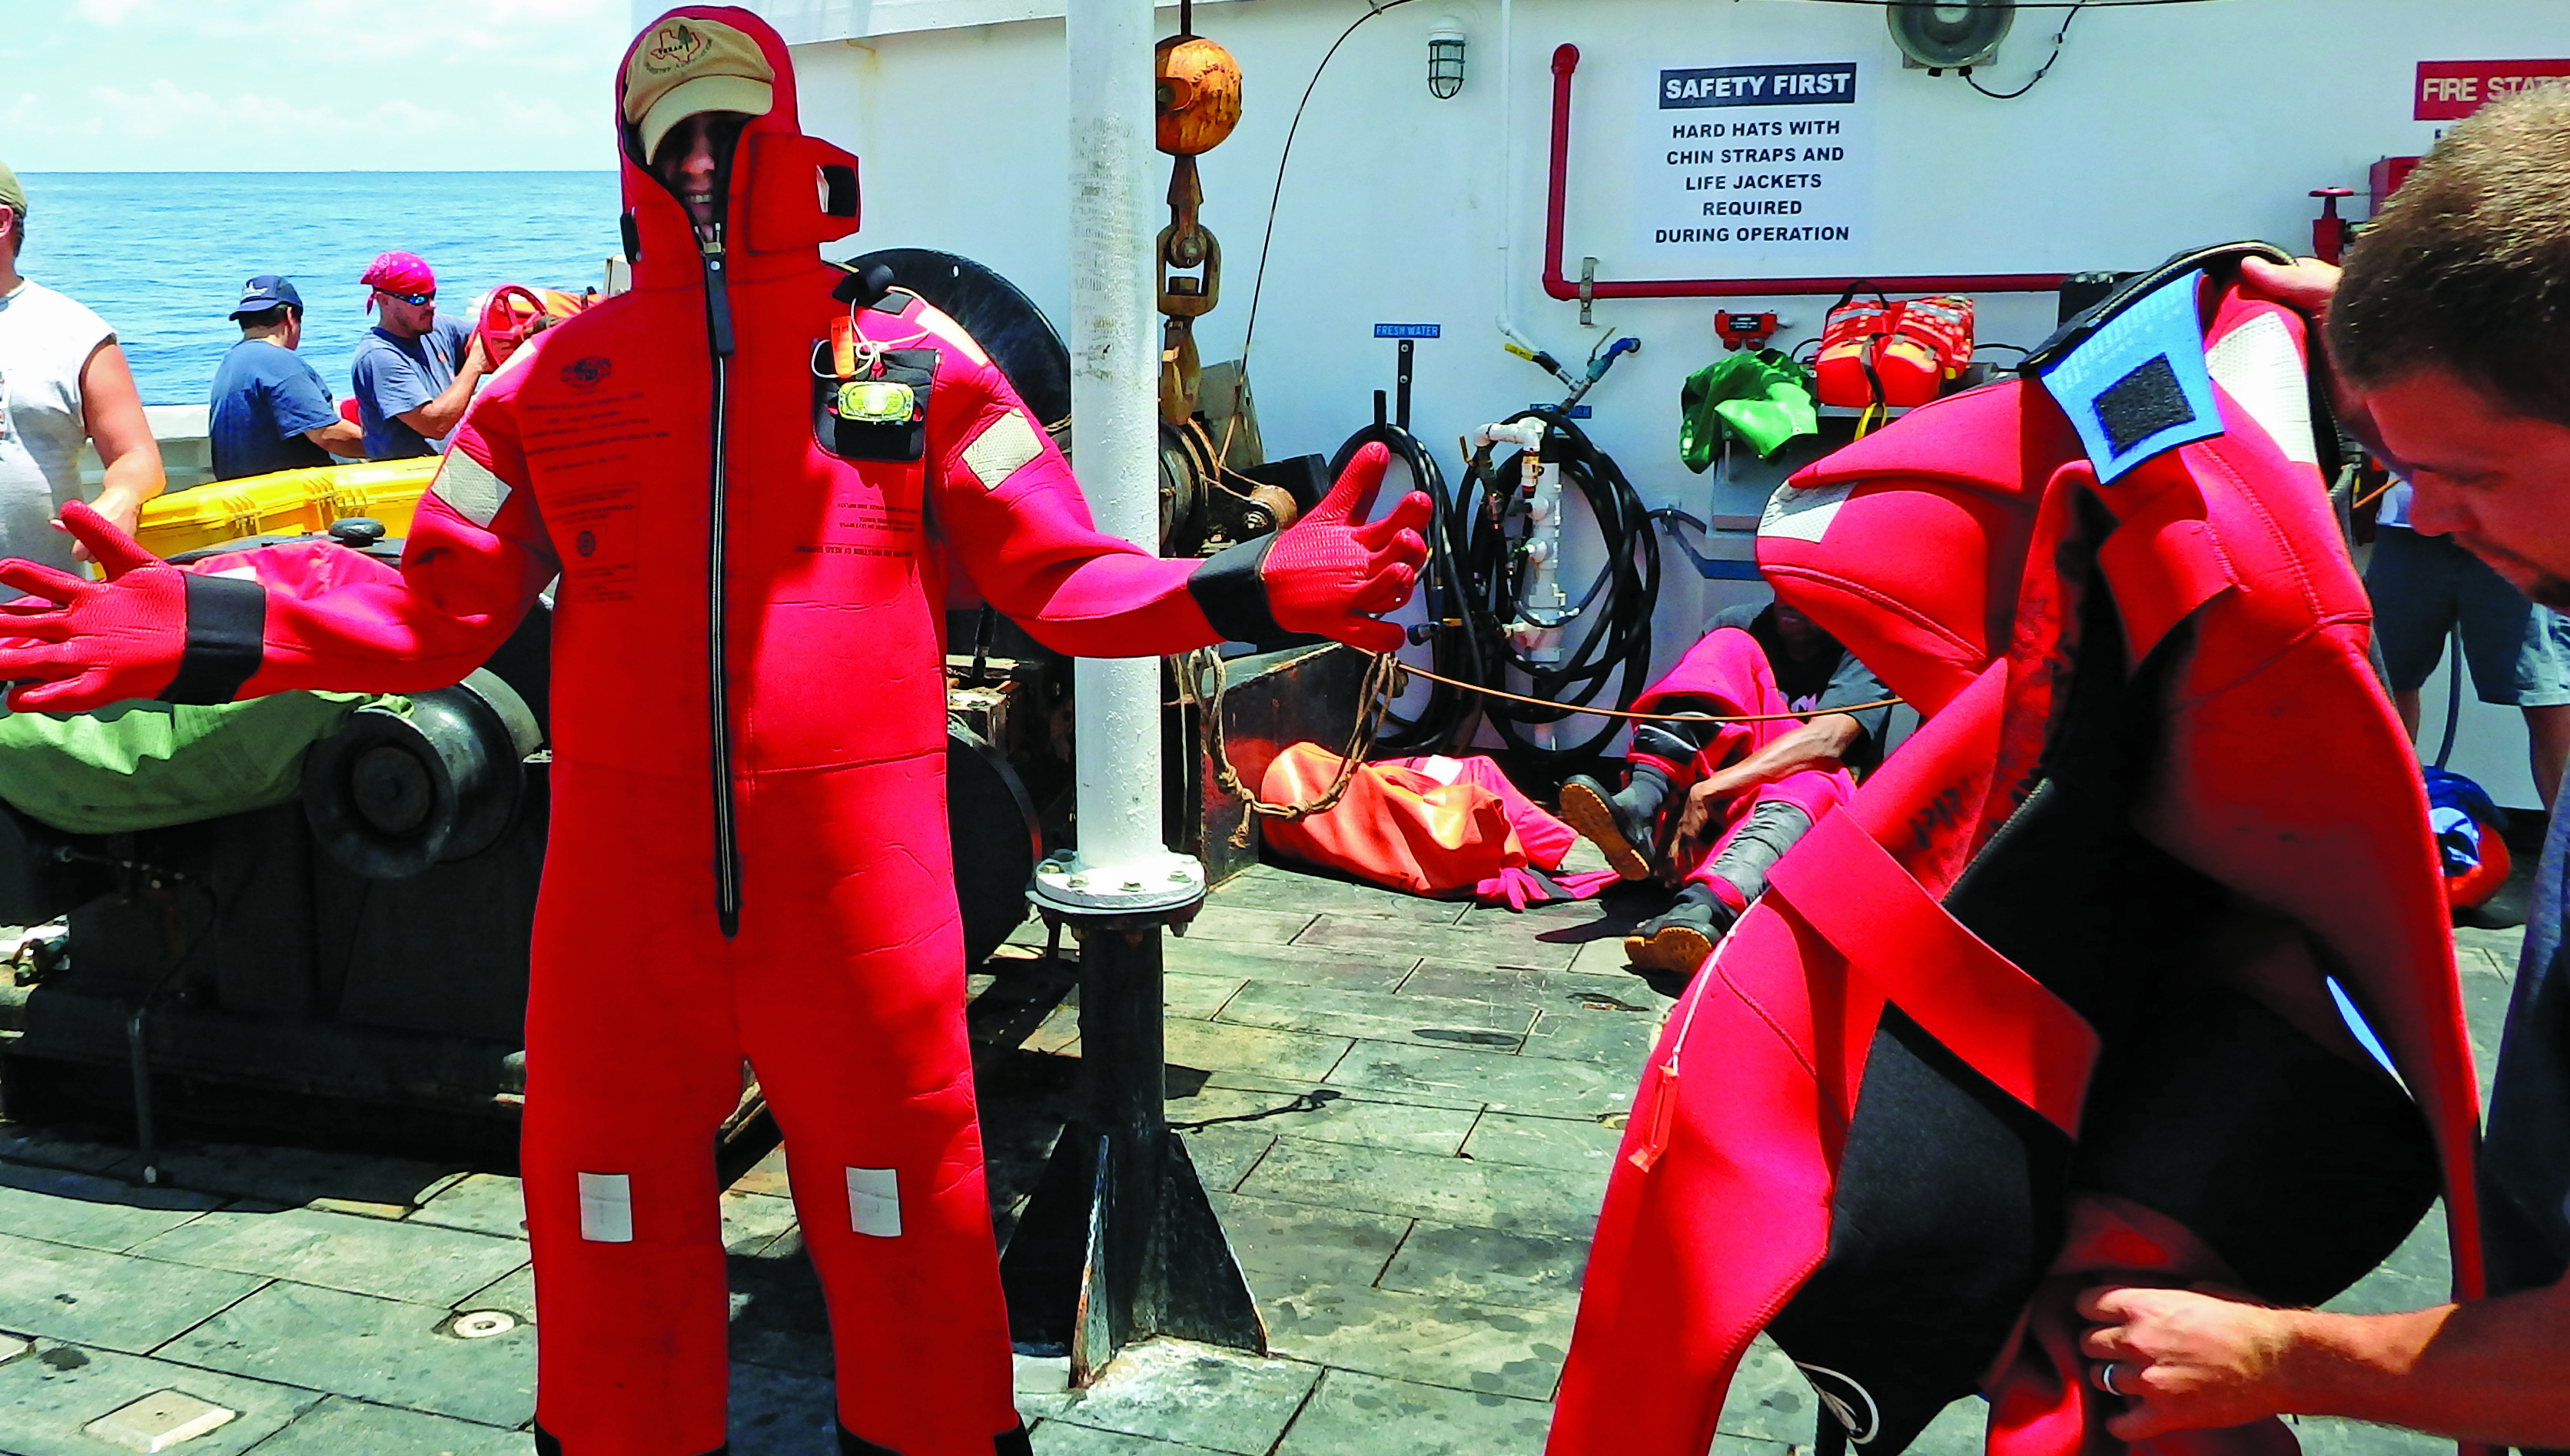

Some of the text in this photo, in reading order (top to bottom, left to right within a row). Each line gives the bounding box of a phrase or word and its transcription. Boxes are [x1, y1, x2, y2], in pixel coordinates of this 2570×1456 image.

[1665, 73, 1851, 99] SAFETY FIRST
[2423, 78, 2479, 102] FIRE
[1672, 120, 1841, 138] HARD HATS WITH
[1666, 147, 1844, 165] CHIN STRAPS AND
[1685, 174, 1821, 191] LIFE JACKETS
[1703, 201, 1802, 217] REQUIRED
[1655, 227, 1849, 244] DURING OPERATION
[1376, 325, 1439, 336] FRESH WATER
